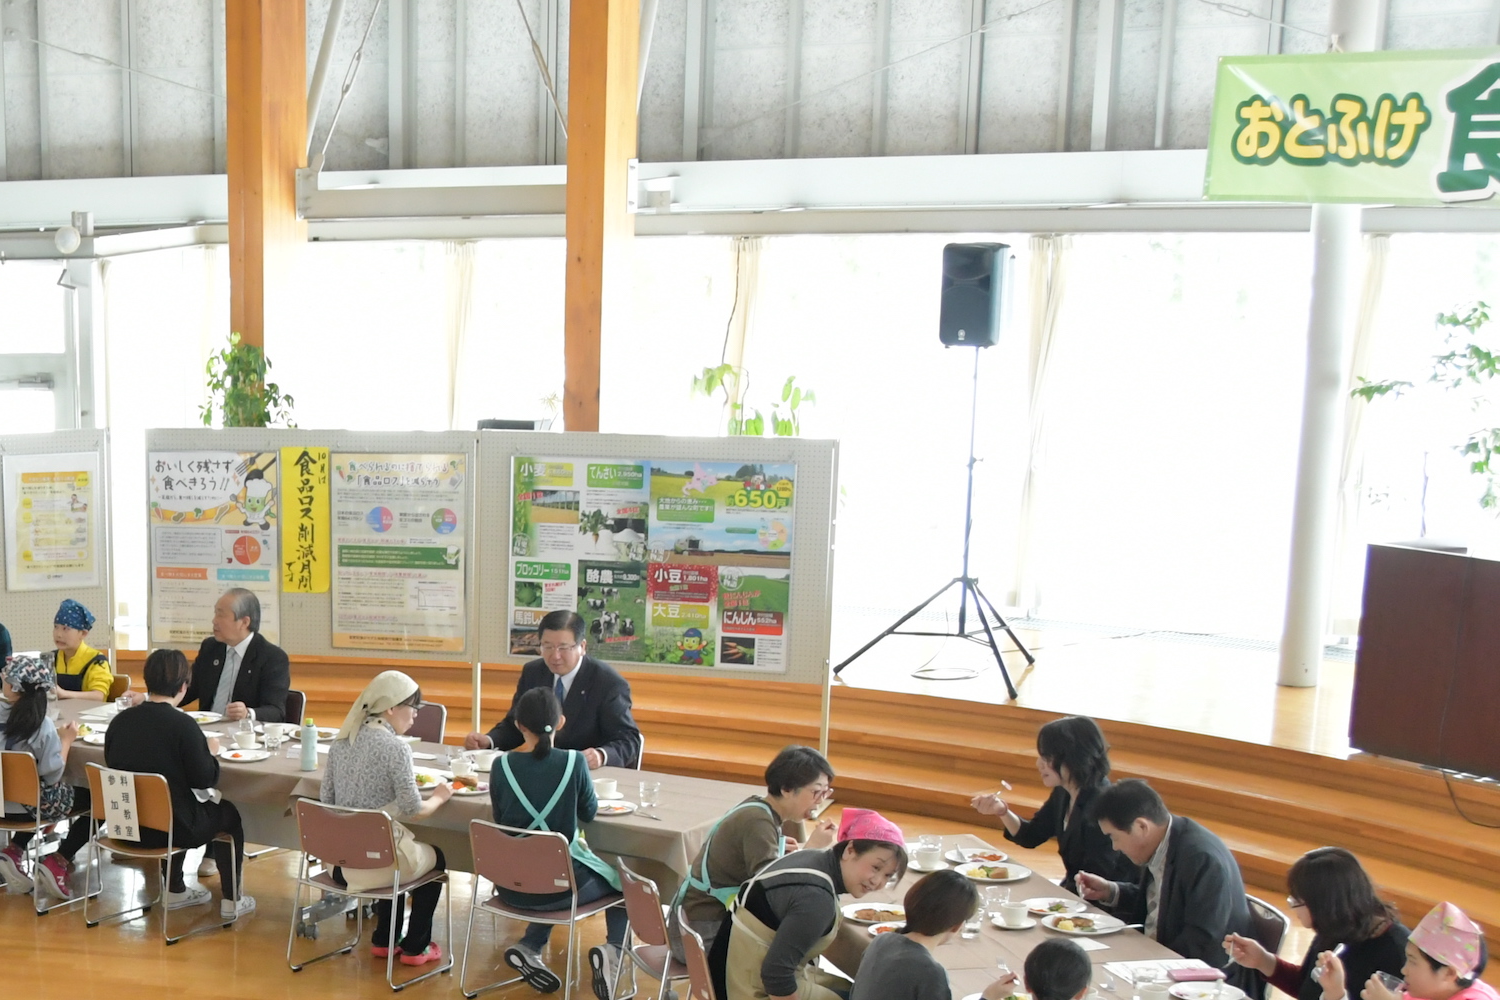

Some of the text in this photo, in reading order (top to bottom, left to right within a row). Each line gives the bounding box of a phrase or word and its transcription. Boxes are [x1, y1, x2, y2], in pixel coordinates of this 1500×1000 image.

[1232, 93, 1431, 168] おとふけ
[154, 458, 234, 474] おいしく残さず
[520, 462, 546, 477] 小麦
[589, 466, 617, 480] てんさい
[294, 450, 318, 591] 食品ロス削減月間
[516, 563, 549, 576] ブロッコリー
[586, 568, 614, 584] 酪農
[654, 568, 682, 584] 小豆
[653, 604, 680, 618] 大豆
[723, 611, 756, 625] にんじん
[107, 774, 121, 836] 参加者
[119, 775, 134, 837] 料理教室
